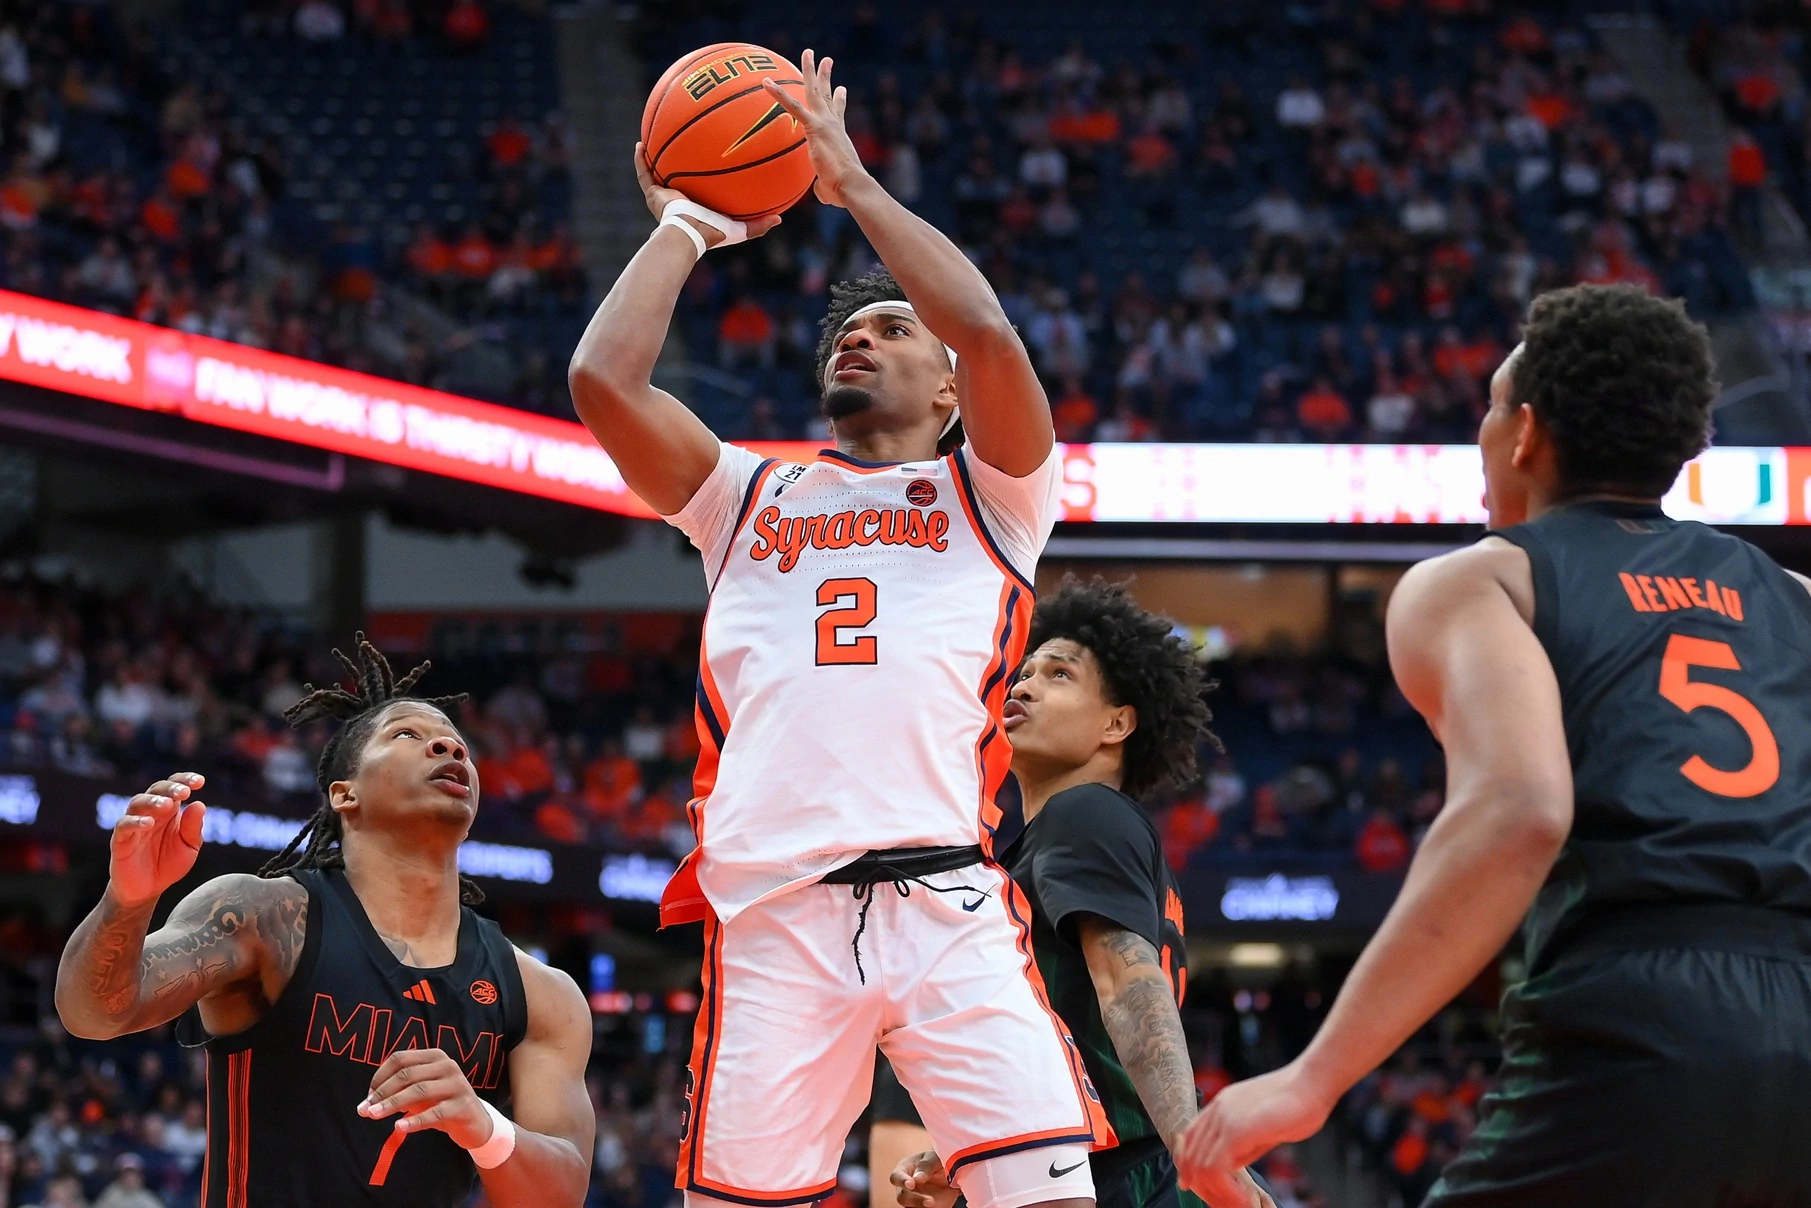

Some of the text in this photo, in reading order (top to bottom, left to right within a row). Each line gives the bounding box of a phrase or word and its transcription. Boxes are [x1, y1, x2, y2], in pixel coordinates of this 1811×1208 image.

[685, 55, 779, 102] ELITE
[784, 470, 802, 480] 21
[750, 505, 949, 573] Syracuse
[815, 577, 878, 666] 2
[1618, 572, 1744, 621] RENEAU
[1658, 633, 1780, 798] 5
[304, 992, 505, 1089] MIAMI
